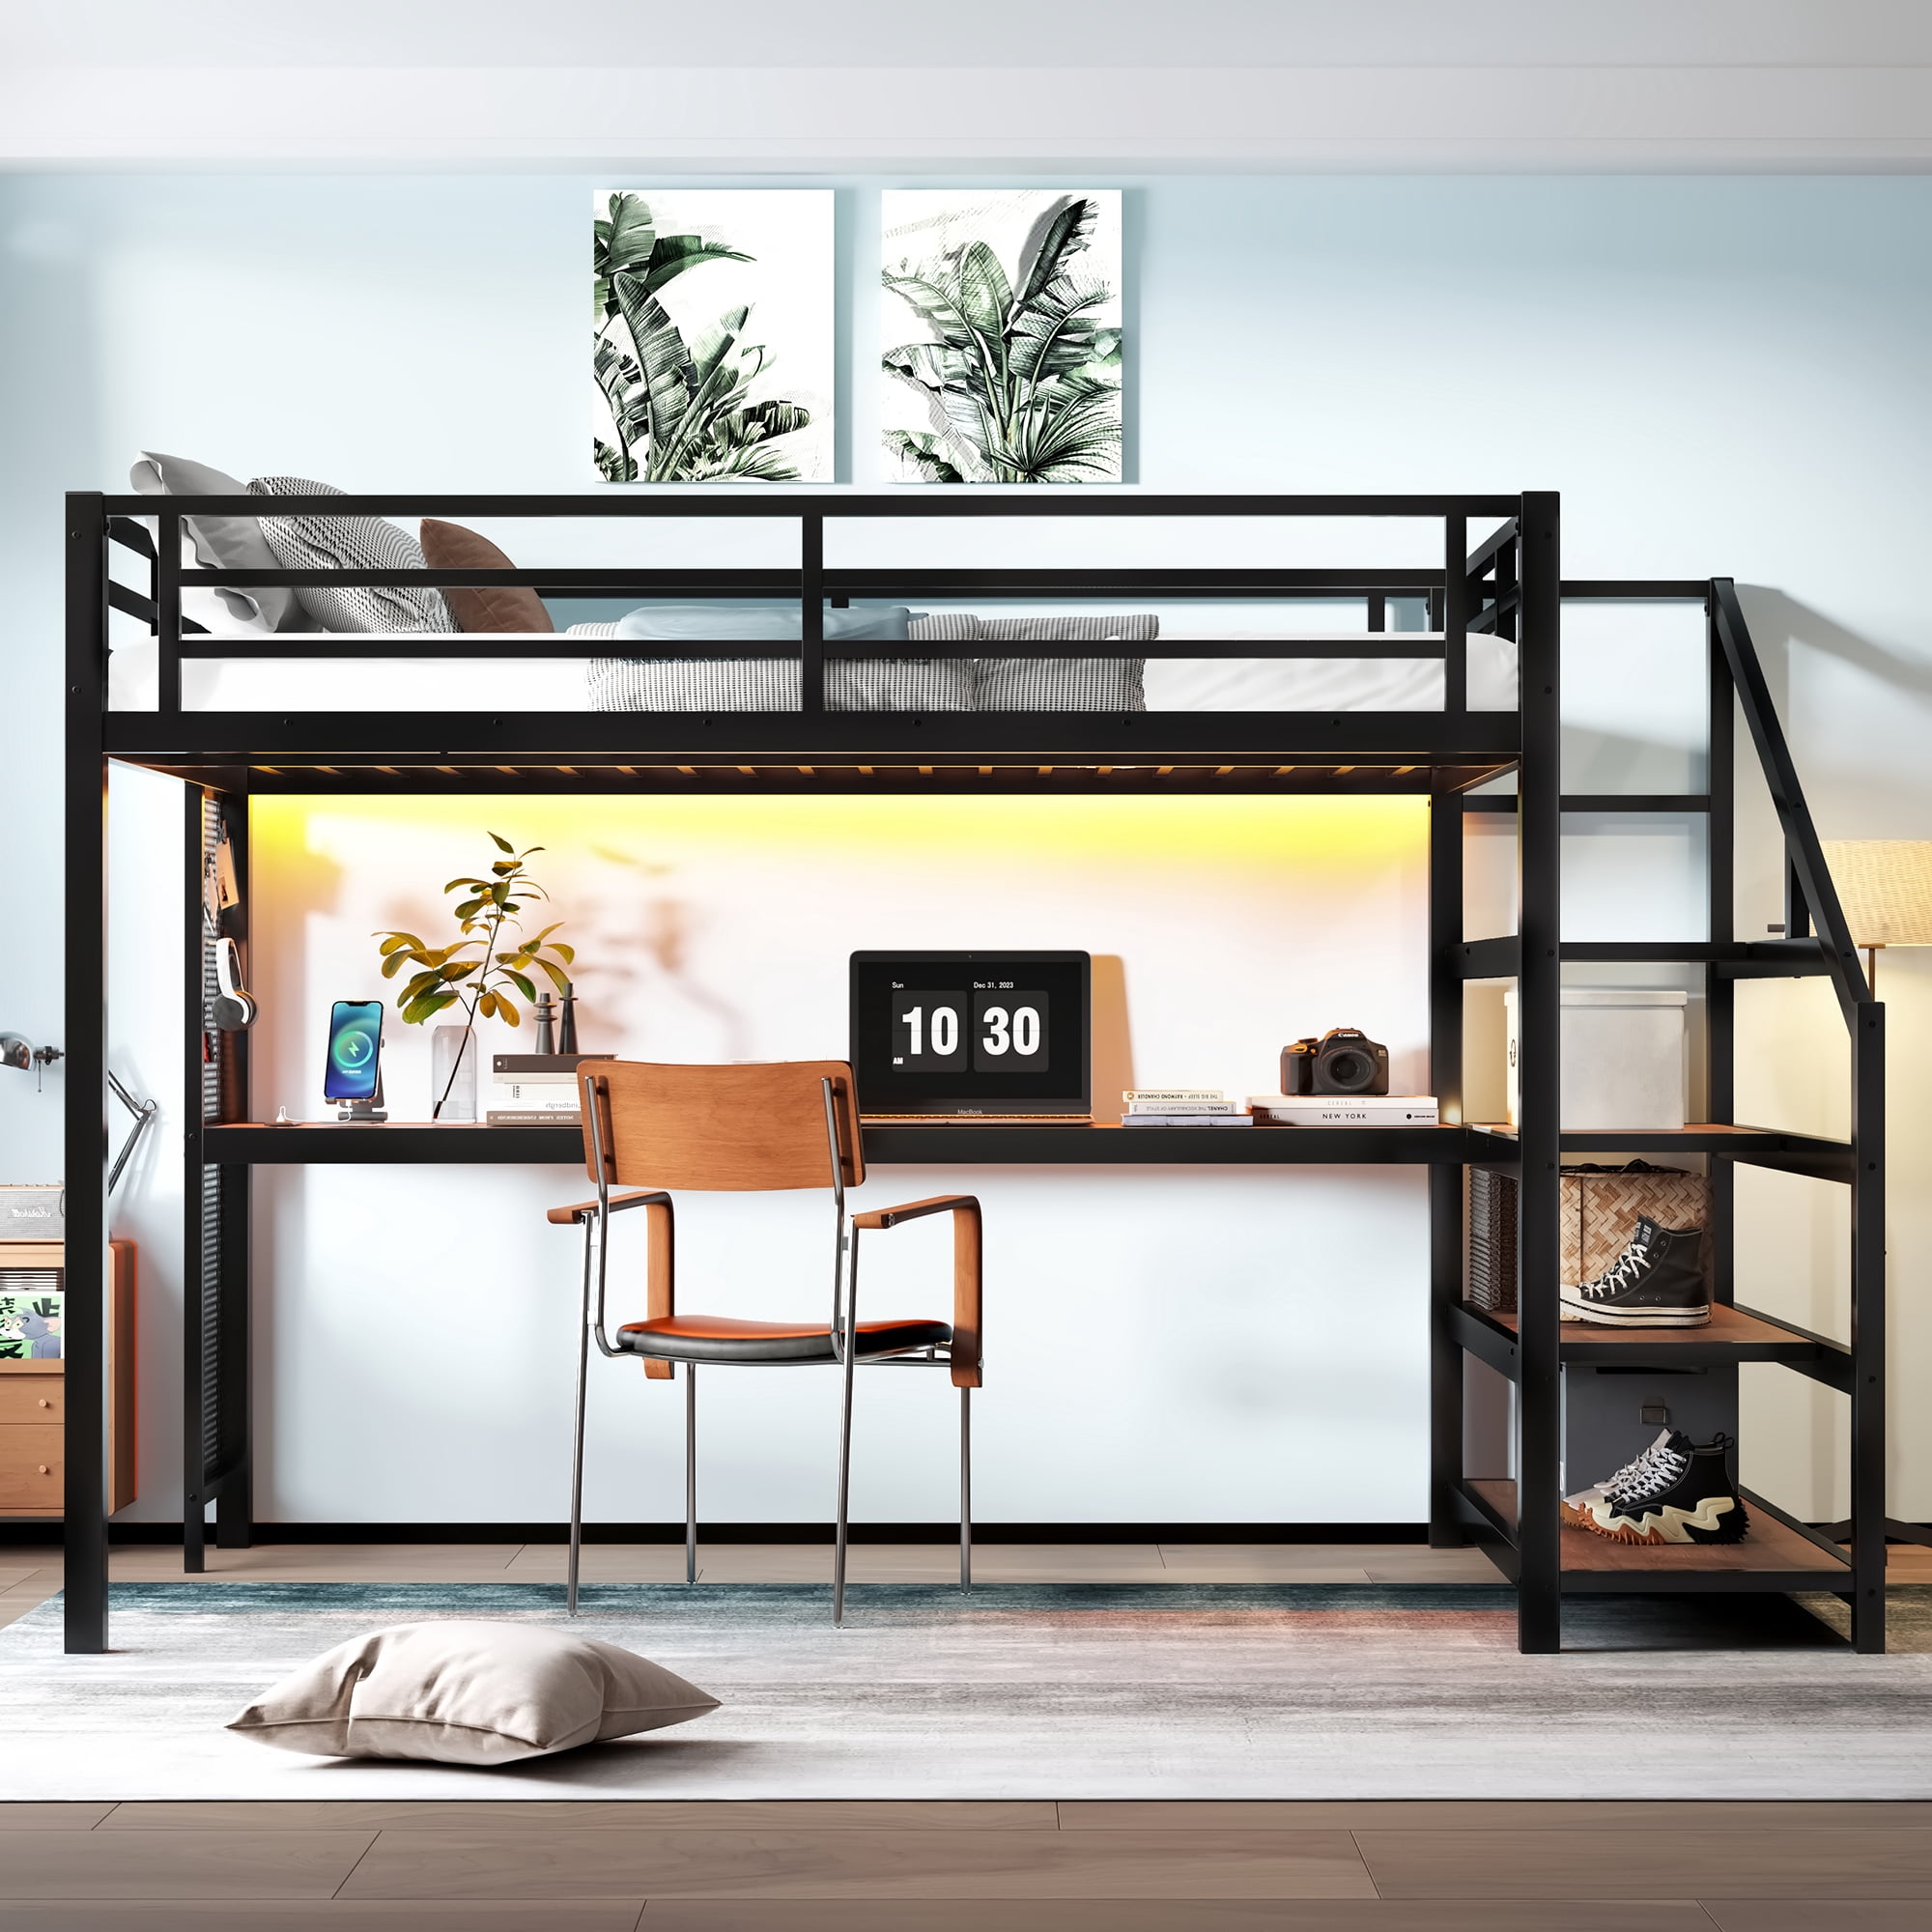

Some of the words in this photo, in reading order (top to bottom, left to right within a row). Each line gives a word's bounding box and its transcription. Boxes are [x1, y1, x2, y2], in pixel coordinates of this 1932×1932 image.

[987, 981, 997, 990] 31,
[902, 1007, 958, 1055] 10
[982, 1007, 1040, 1056] 30
